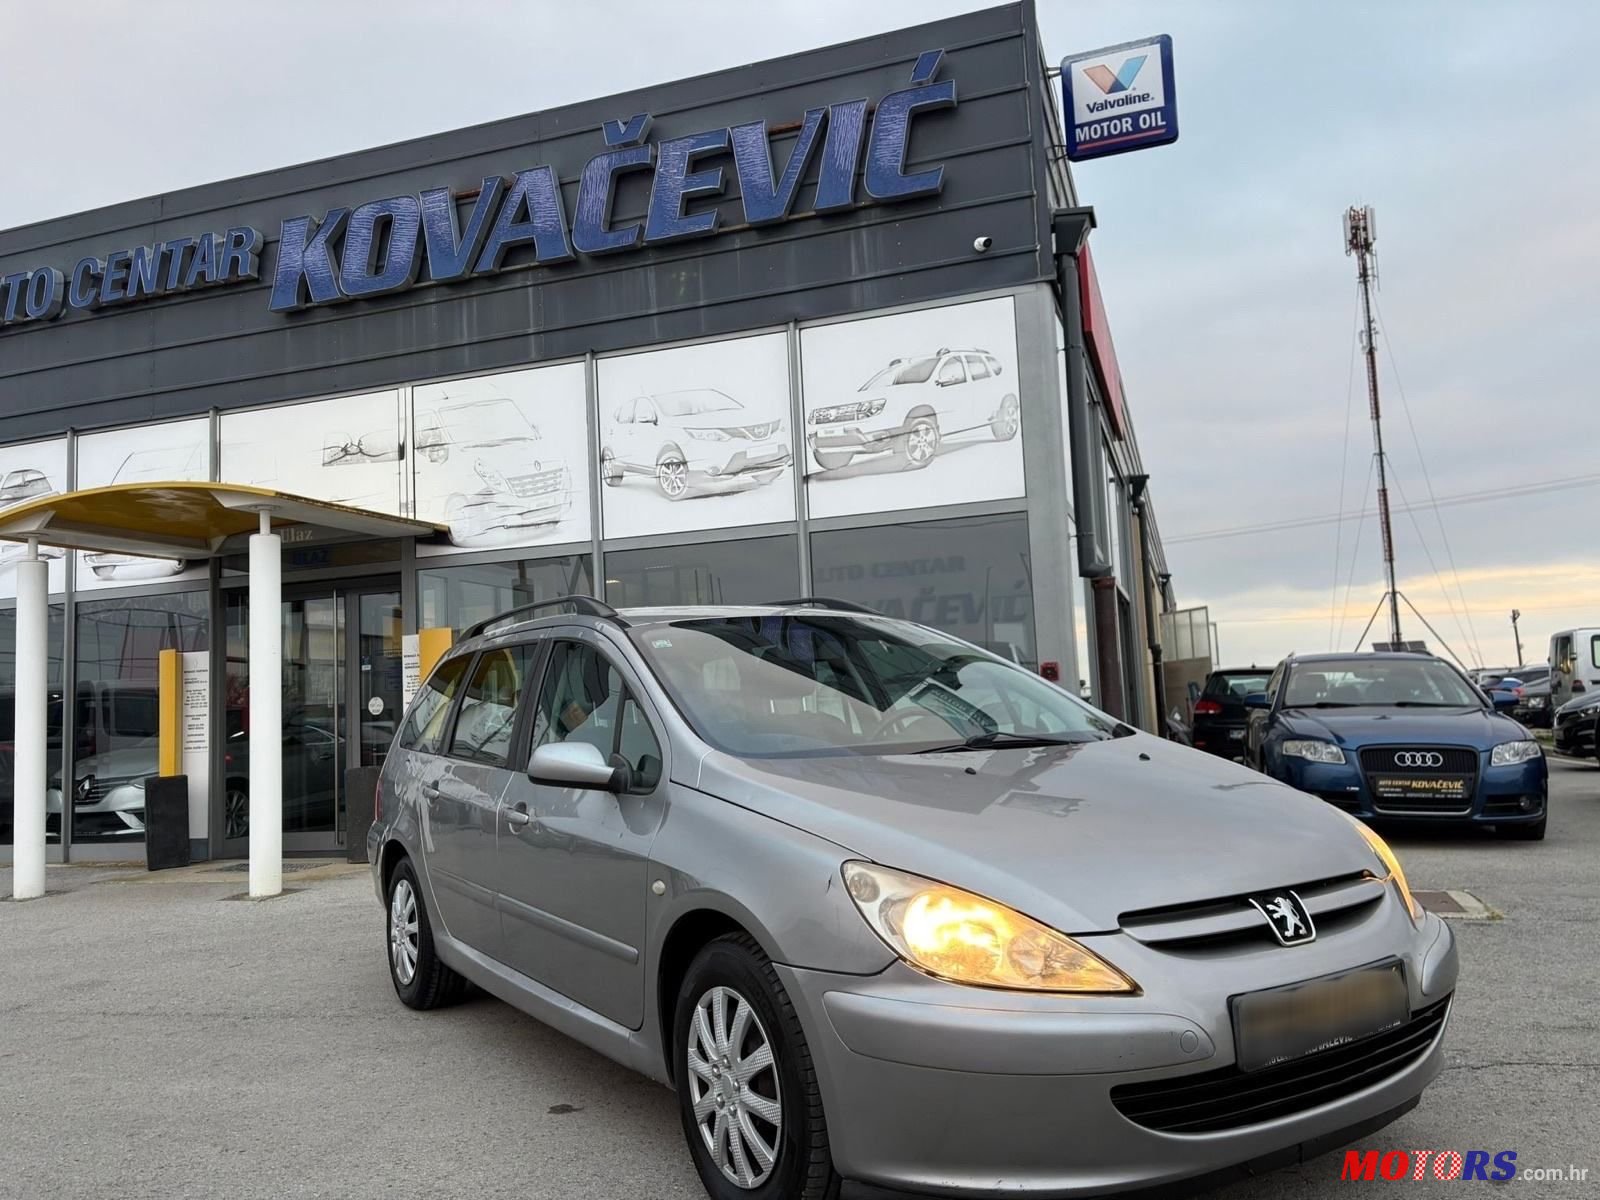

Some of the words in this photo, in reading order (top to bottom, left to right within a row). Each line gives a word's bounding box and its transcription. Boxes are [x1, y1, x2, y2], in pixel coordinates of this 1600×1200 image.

[1086, 92, 1151, 114] Valvoline
[1075, 117, 1133, 143] MOTOR
[1139, 111, 1167, 129] OIL
[0, 265, 62, 322] TO
[69, 225, 263, 310] CENTAR
[268, 48, 957, 313] KOVAČEVIĆ
[1411, 779, 1463, 788] KOVAČEVIĆ
